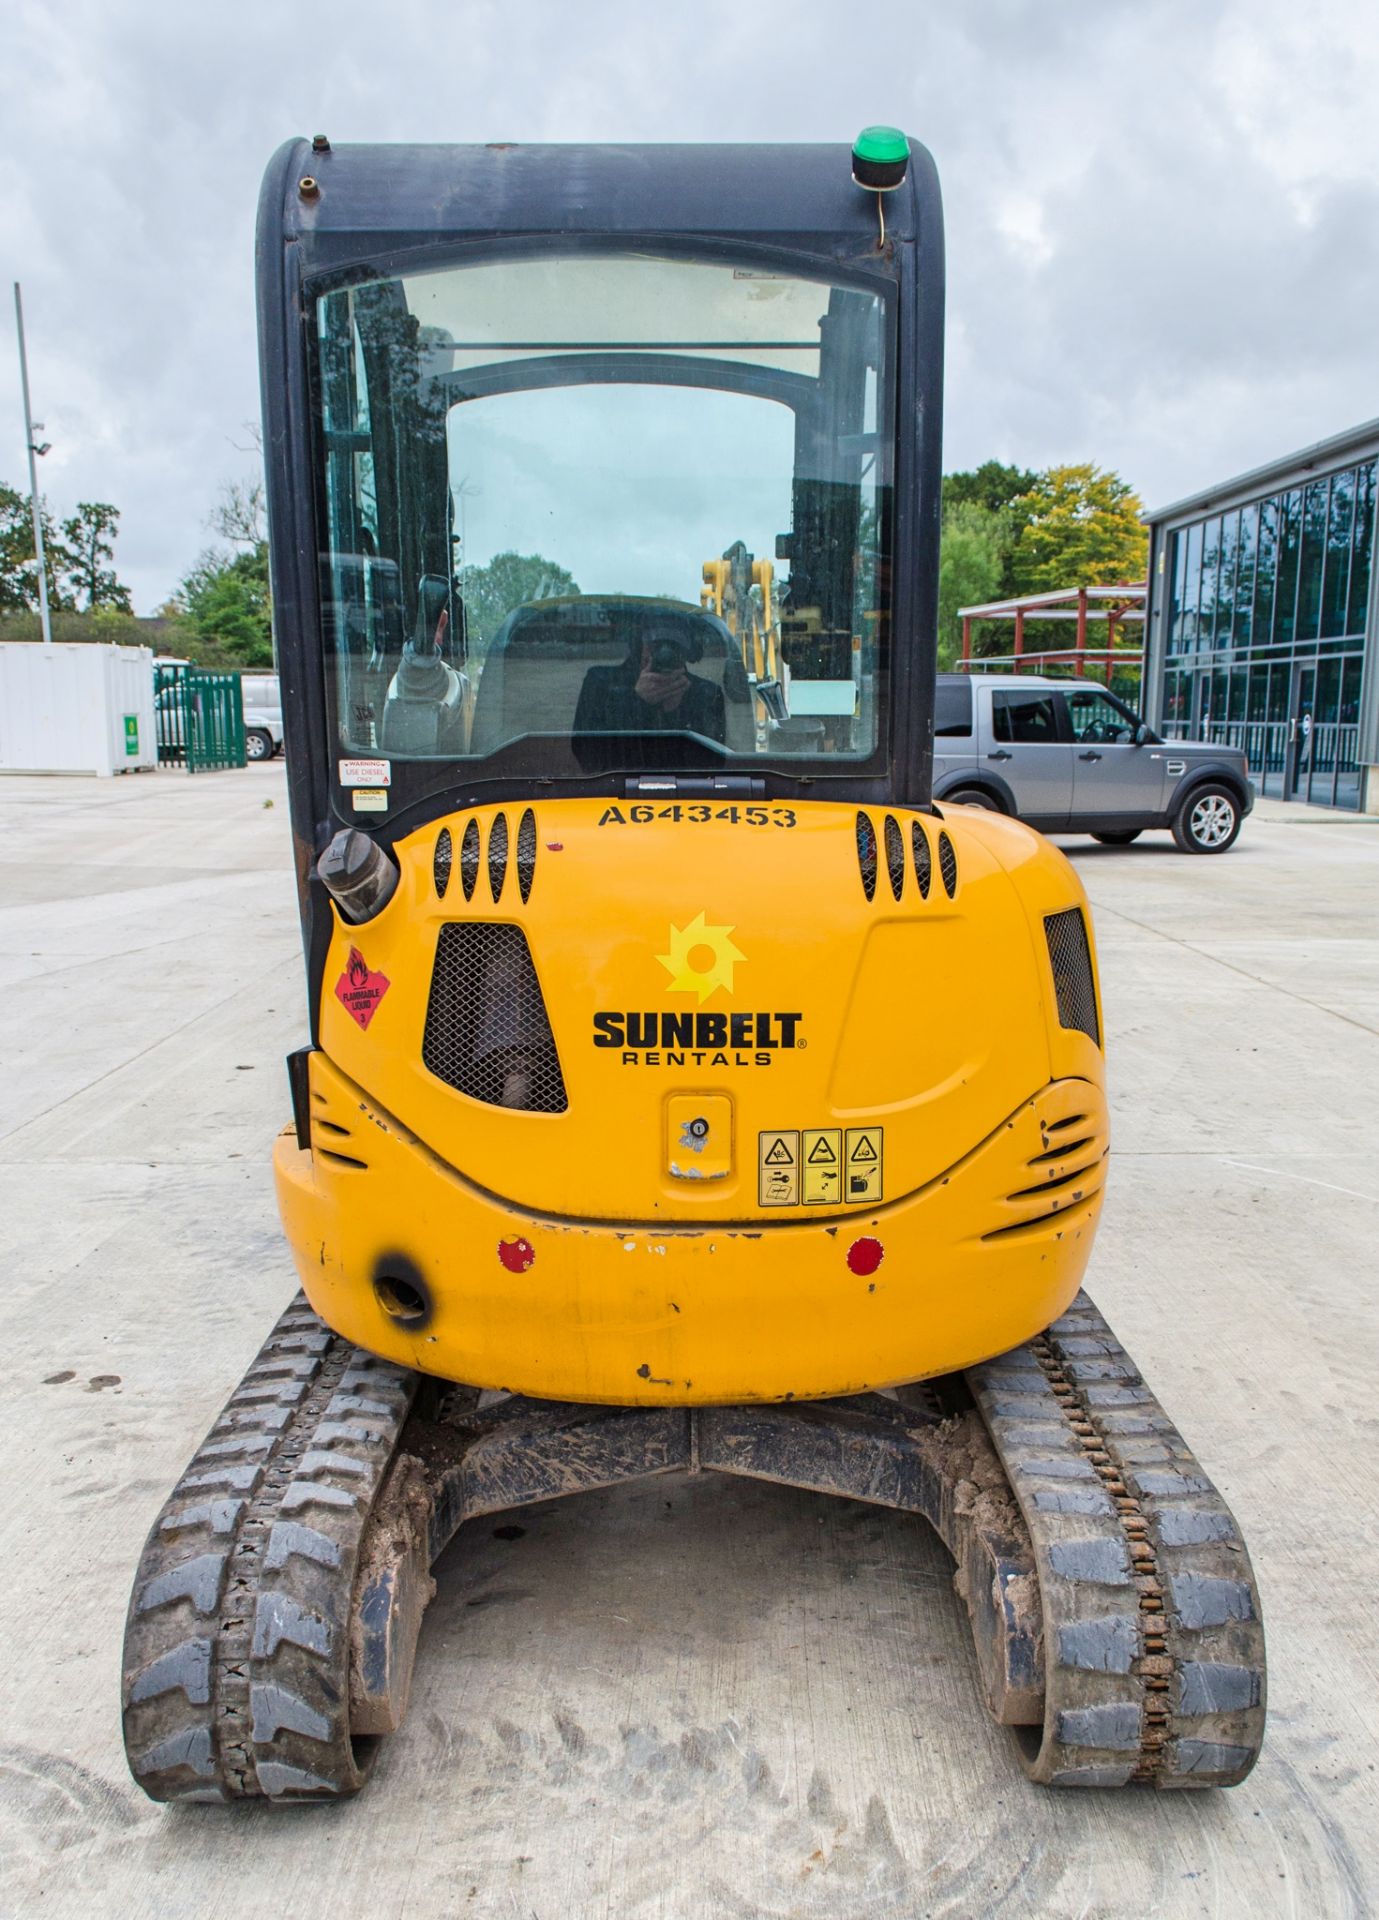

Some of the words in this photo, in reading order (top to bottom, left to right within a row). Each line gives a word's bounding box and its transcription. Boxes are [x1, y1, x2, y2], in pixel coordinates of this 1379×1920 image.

[598, 805, 797, 828] A643453
[343, 989, 380, 1002] FLAMMABLE
[352, 1000, 371, 1011] LIQUID
[360, 1013, 365, 1023] 3
[622, 1052, 772, 1066] RENTALS
